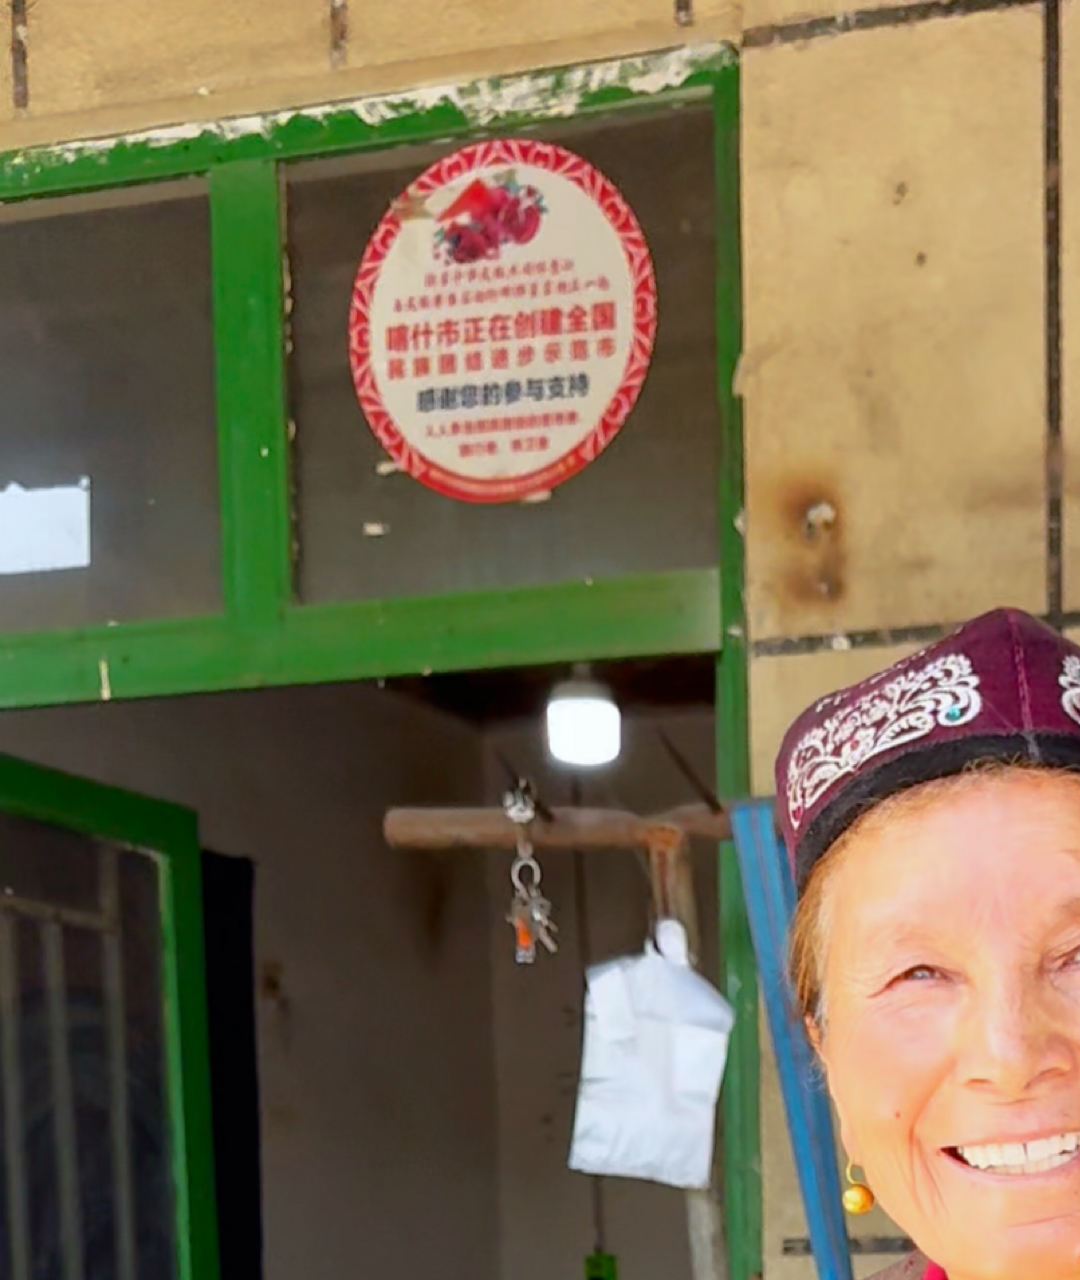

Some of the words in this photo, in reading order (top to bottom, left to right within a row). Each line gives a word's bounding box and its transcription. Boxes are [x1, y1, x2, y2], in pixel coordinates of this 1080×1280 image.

[386, 302, 616, 352] 喀什市正在创建全国
[417, 371, 589, 412] 感谢您的参与支持
